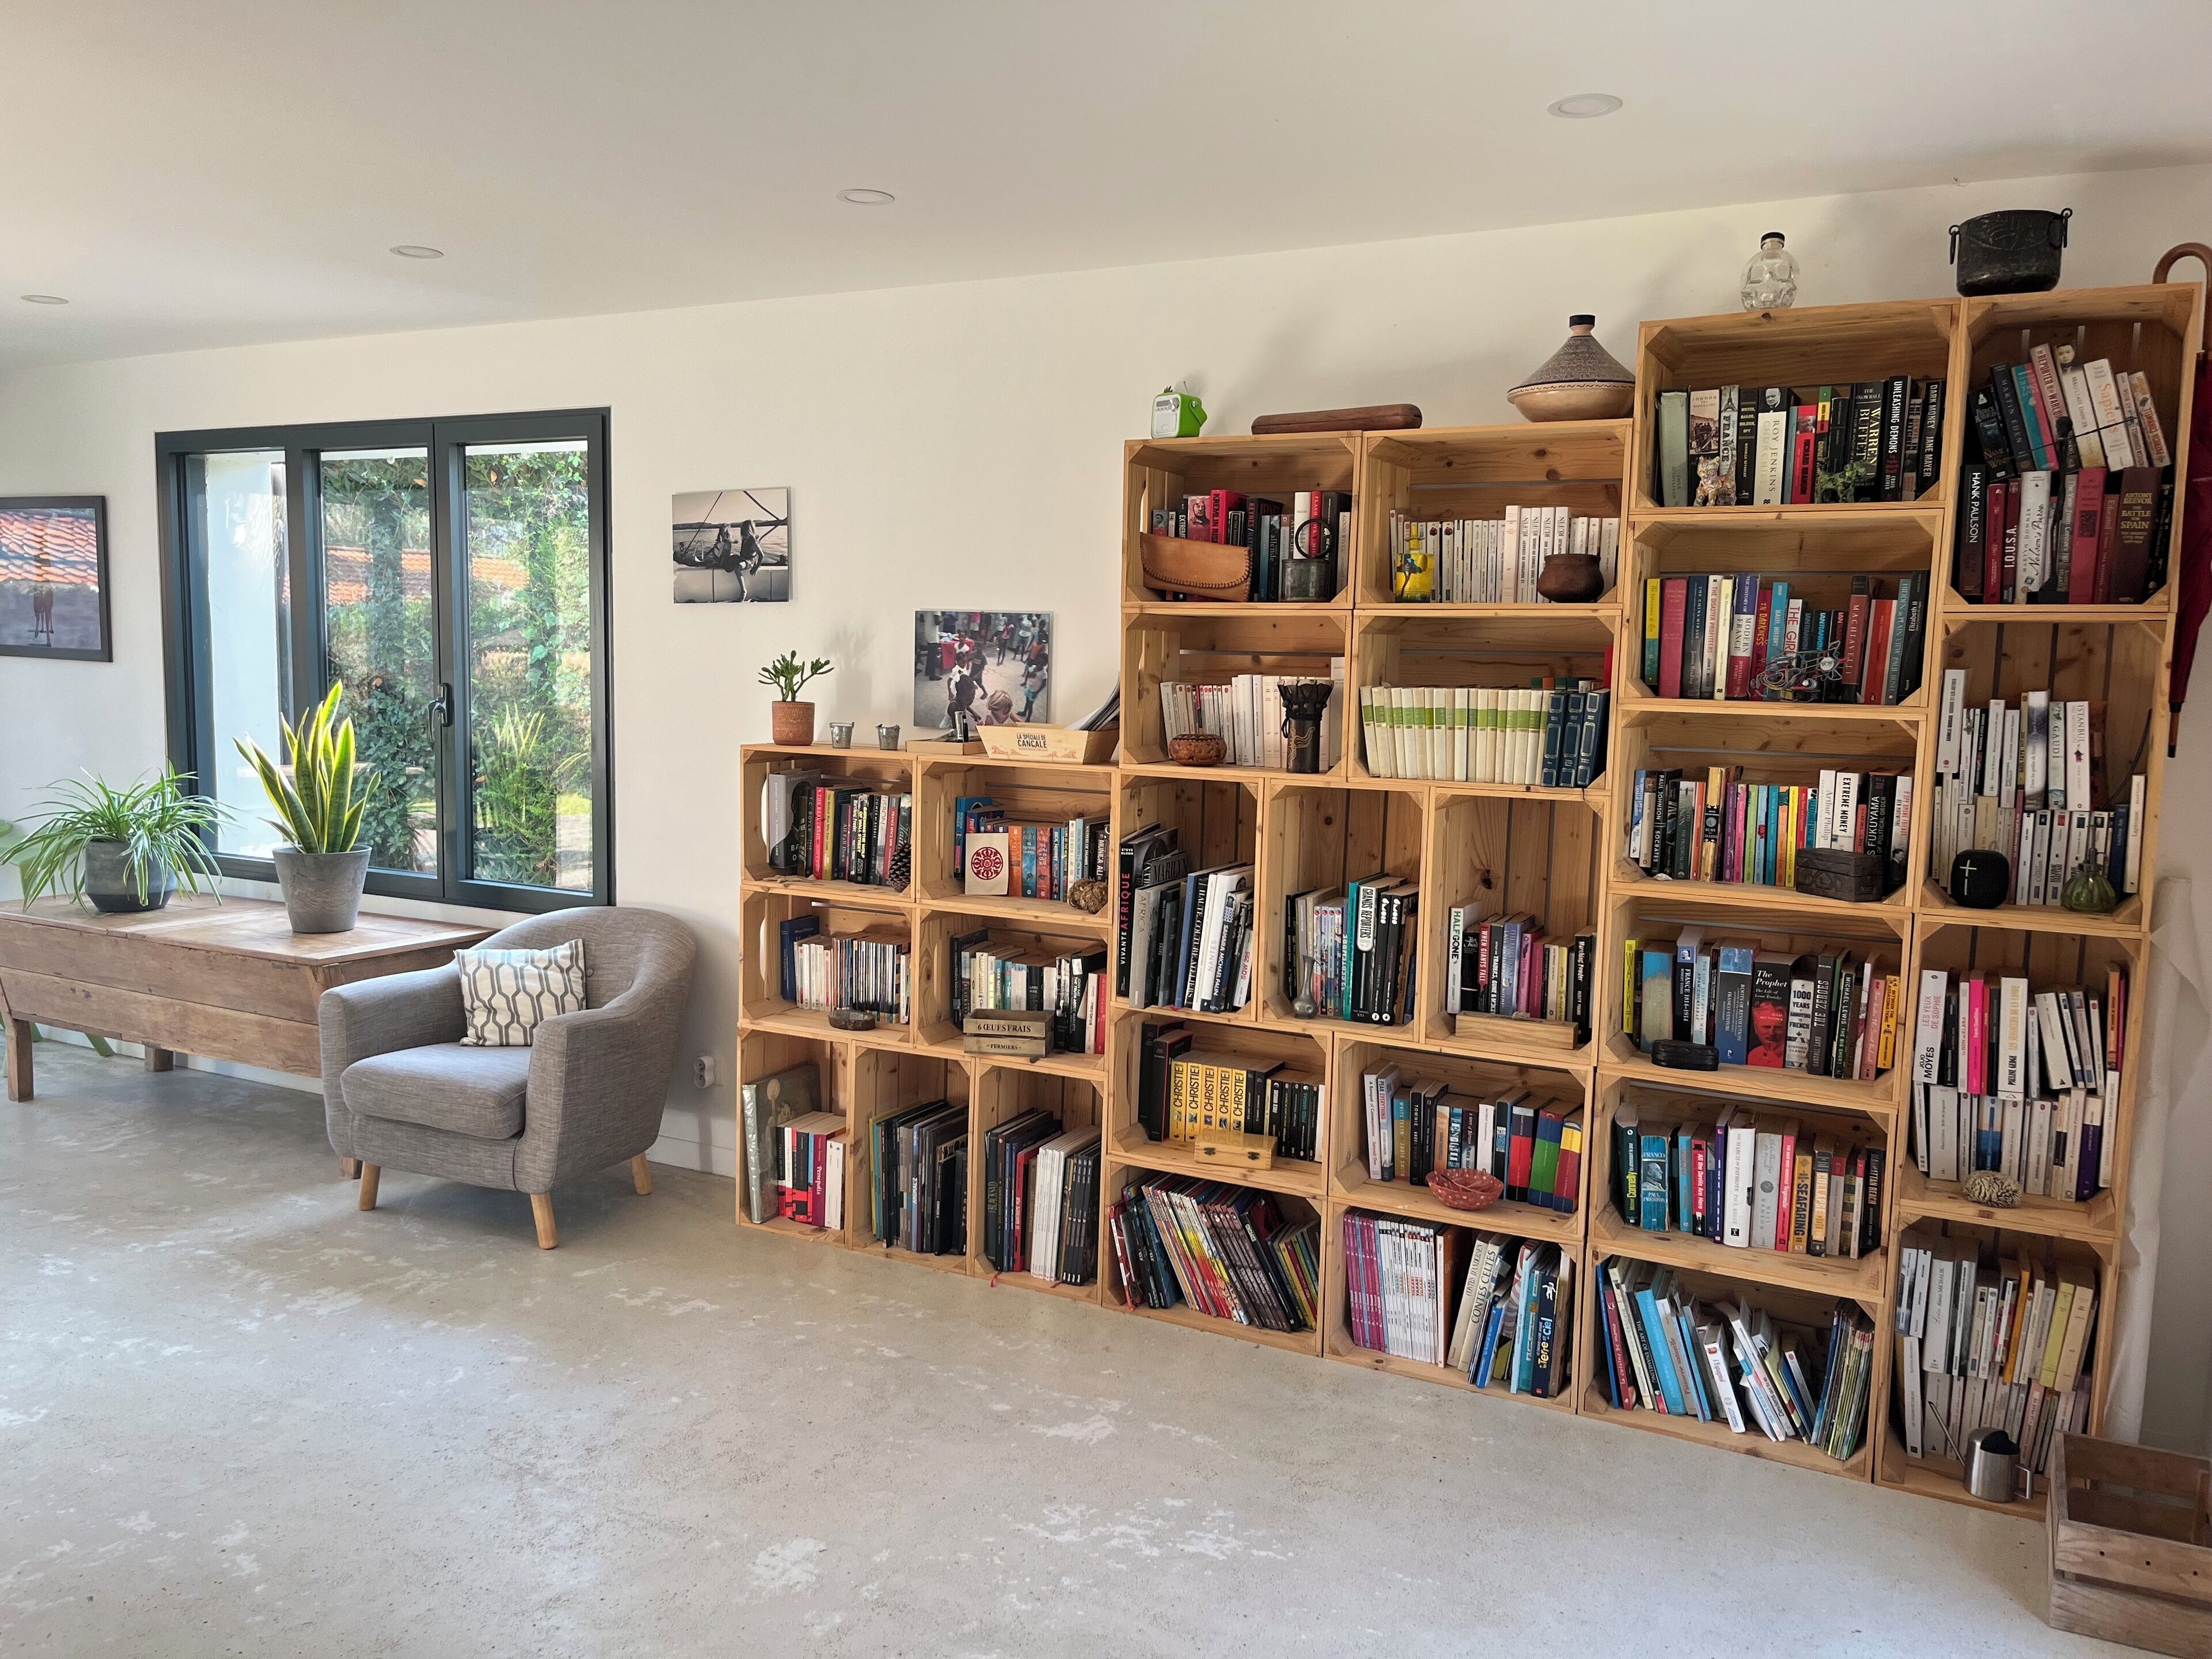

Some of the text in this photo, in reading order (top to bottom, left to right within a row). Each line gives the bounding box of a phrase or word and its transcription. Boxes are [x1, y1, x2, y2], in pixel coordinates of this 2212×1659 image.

[1888, 381, 1903, 454] UNLEASHING DEMONS
[1922, 384, 1937, 482] DARK MONEY JANE MAYER
[1768, 420, 1780, 493] ROY JENKINS
[1211, 493, 1221, 527] KREMLIN
[1969, 472, 1981, 543] HANK PAULSON
[1789, 606, 1800, 625] THE
[1734, 618, 1743, 652] FRANCE
[1742, 617, 1752, 653] MODERN
[1846, 607, 1859, 675] MACHIAVELLI
[1017, 739, 1048, 748] CANCALE
[1656, 791, 1664, 820] JOHNSON
[1868, 796, 1880, 846] FUKUYAMA
[1097, 839, 1105, 863] MONICA
[1653, 830, 1661, 862] SOCRATES
[1120, 872, 1130, 930] AFRIQUE
[1138, 894, 1147, 933] AFRICA
[1360, 888, 1374, 940] GRANDS REPORTERS
[1451, 911, 1461, 960] HALF GONE
[1207, 940, 1217, 973] NANTES
[1213, 924, 1229, 996] SAHARA MICHAEL PALIN
[1755, 978, 1788, 988] Prophet
[1757, 969, 1772, 979] The
[1843, 976, 1851, 1004] MICHAEL
[1792, 1001, 1810, 1009] YEARS
[1789, 1021, 1810, 1029] FRENCH
[1924, 1046, 1934, 1079] MOYES
[1794, 1183, 1808, 1236] SEAFARING
[1471, 1250, 1497, 1324] CONTES CELTES
[1537, 1339, 1548, 1366] Terre
